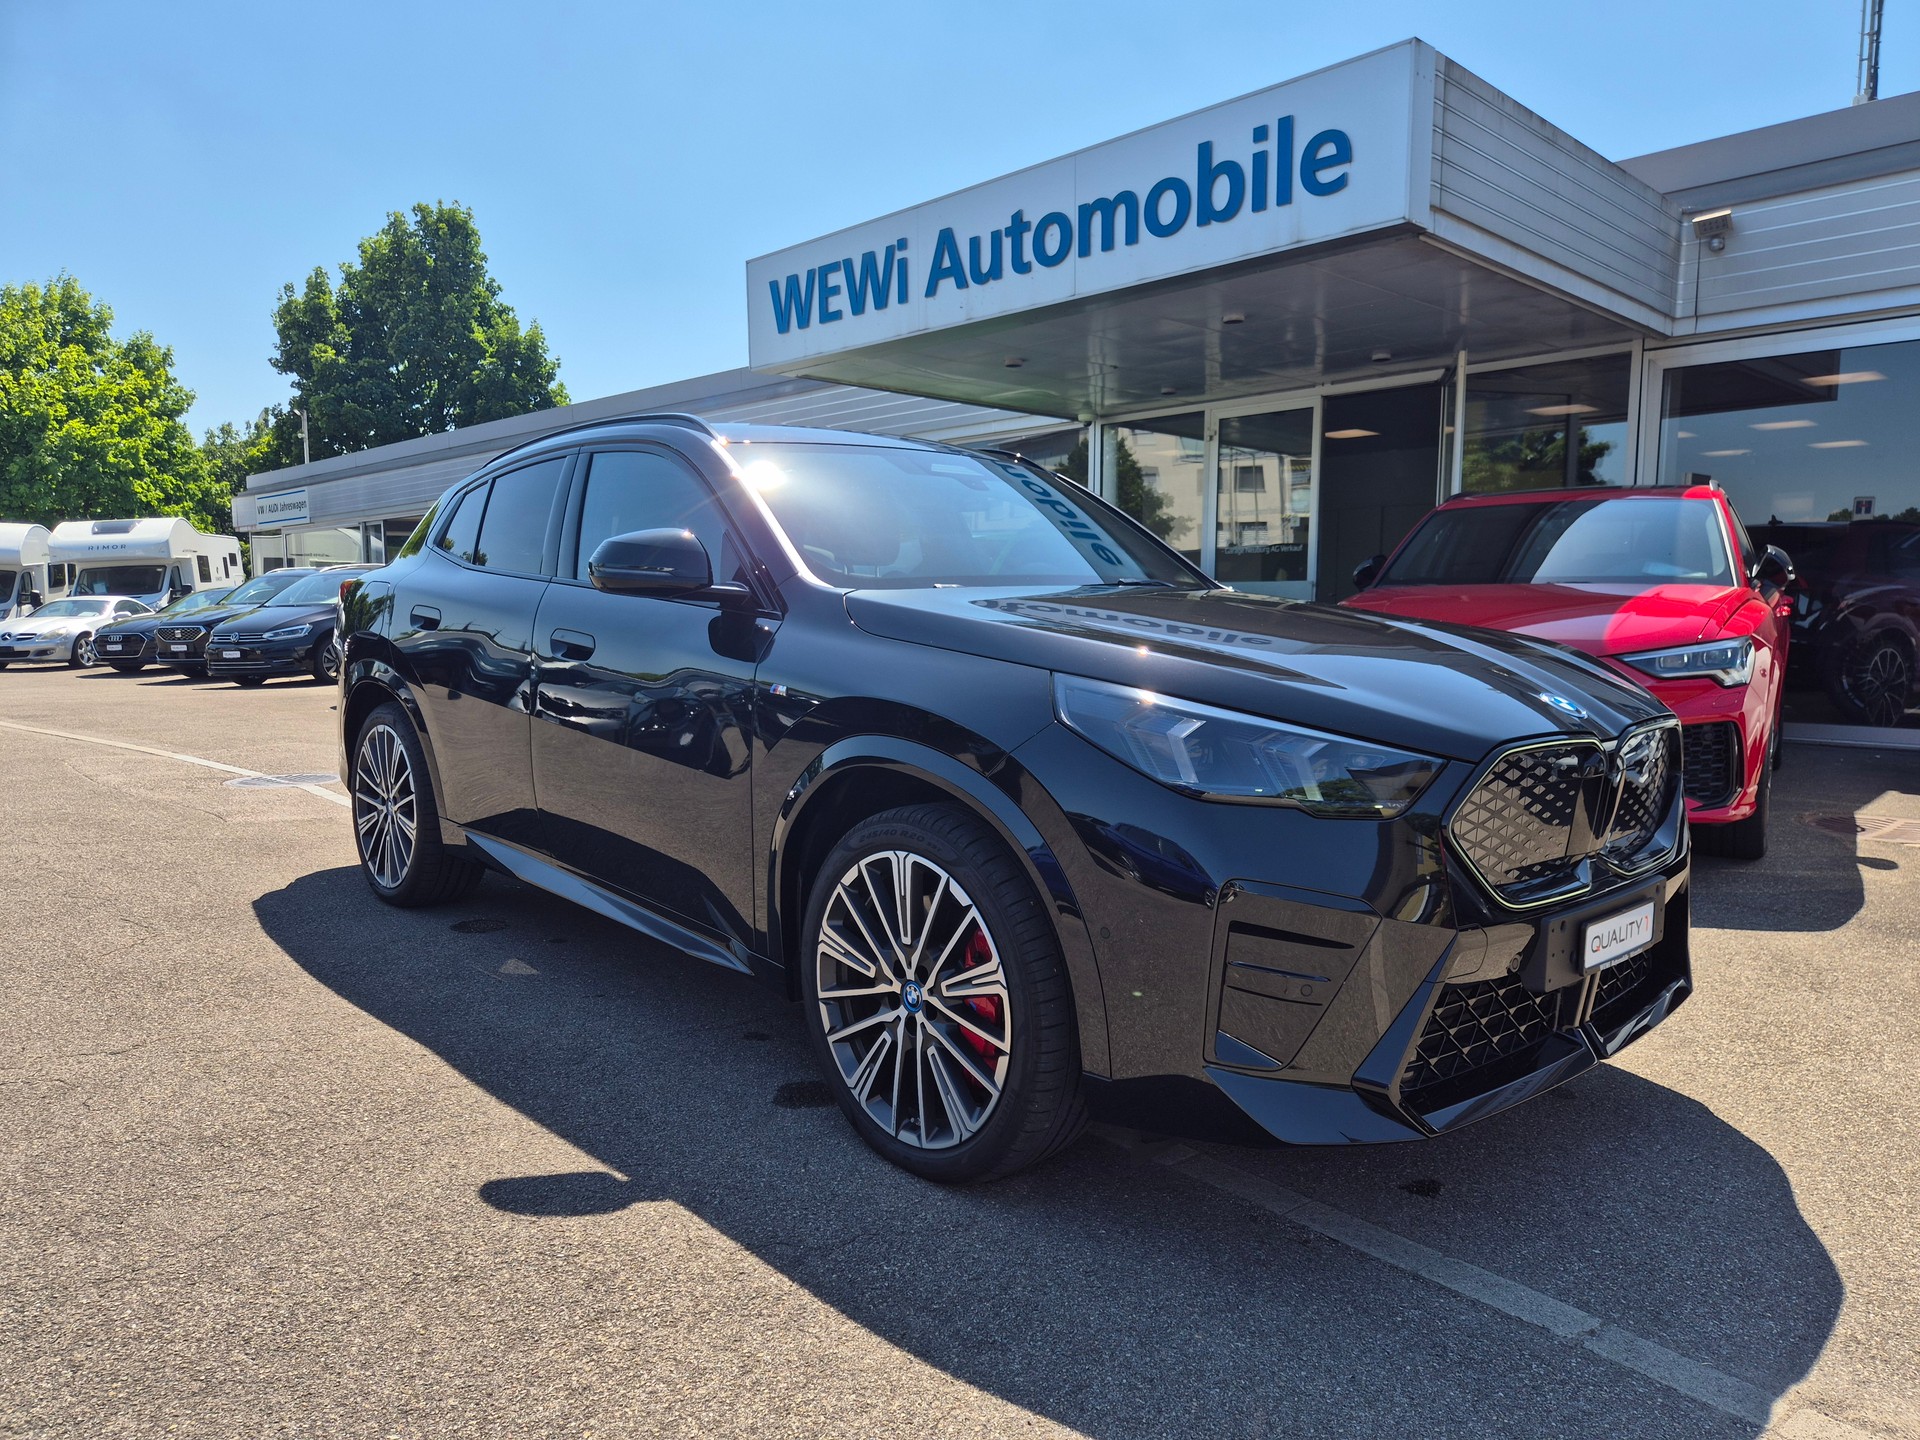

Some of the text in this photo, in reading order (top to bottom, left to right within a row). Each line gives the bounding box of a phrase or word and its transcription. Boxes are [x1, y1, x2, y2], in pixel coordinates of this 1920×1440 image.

[768, 113, 1353, 335] WEWi Automobile
[257, 504, 264, 515] VW
[268, 502, 278, 513] AUDI
[280, 500, 308, 512] Jahreswagen
